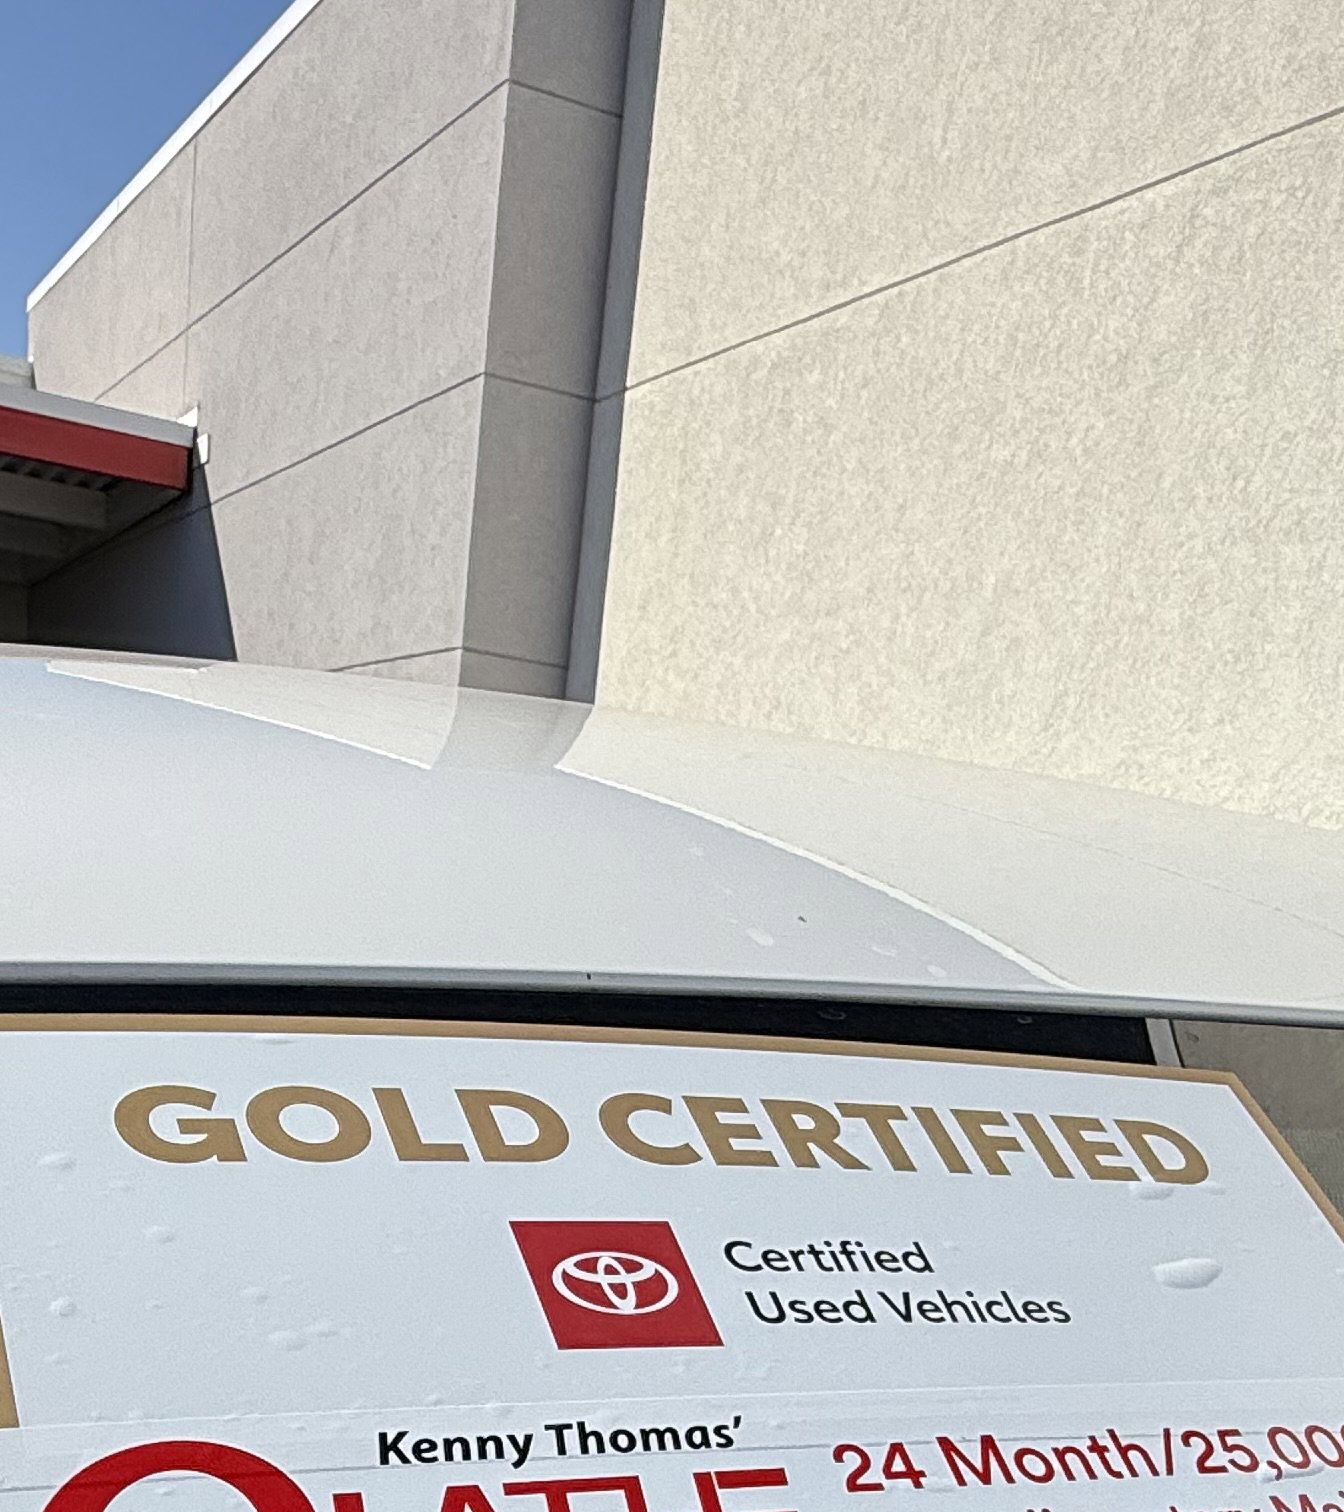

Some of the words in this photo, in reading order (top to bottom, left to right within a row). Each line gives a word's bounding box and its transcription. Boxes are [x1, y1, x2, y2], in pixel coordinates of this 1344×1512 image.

[115, 1085, 569, 1163] GOLD
[600, 1093, 1208, 1184] CERTIFIED
[723, 1240, 936, 1273] Certified
[744, 1289, 877, 1325] Used
[879, 1289, 1072, 1325] Vehicles
[378, 1430, 535, 1470] Kenny
[831, 1441, 926, 1494] 24
